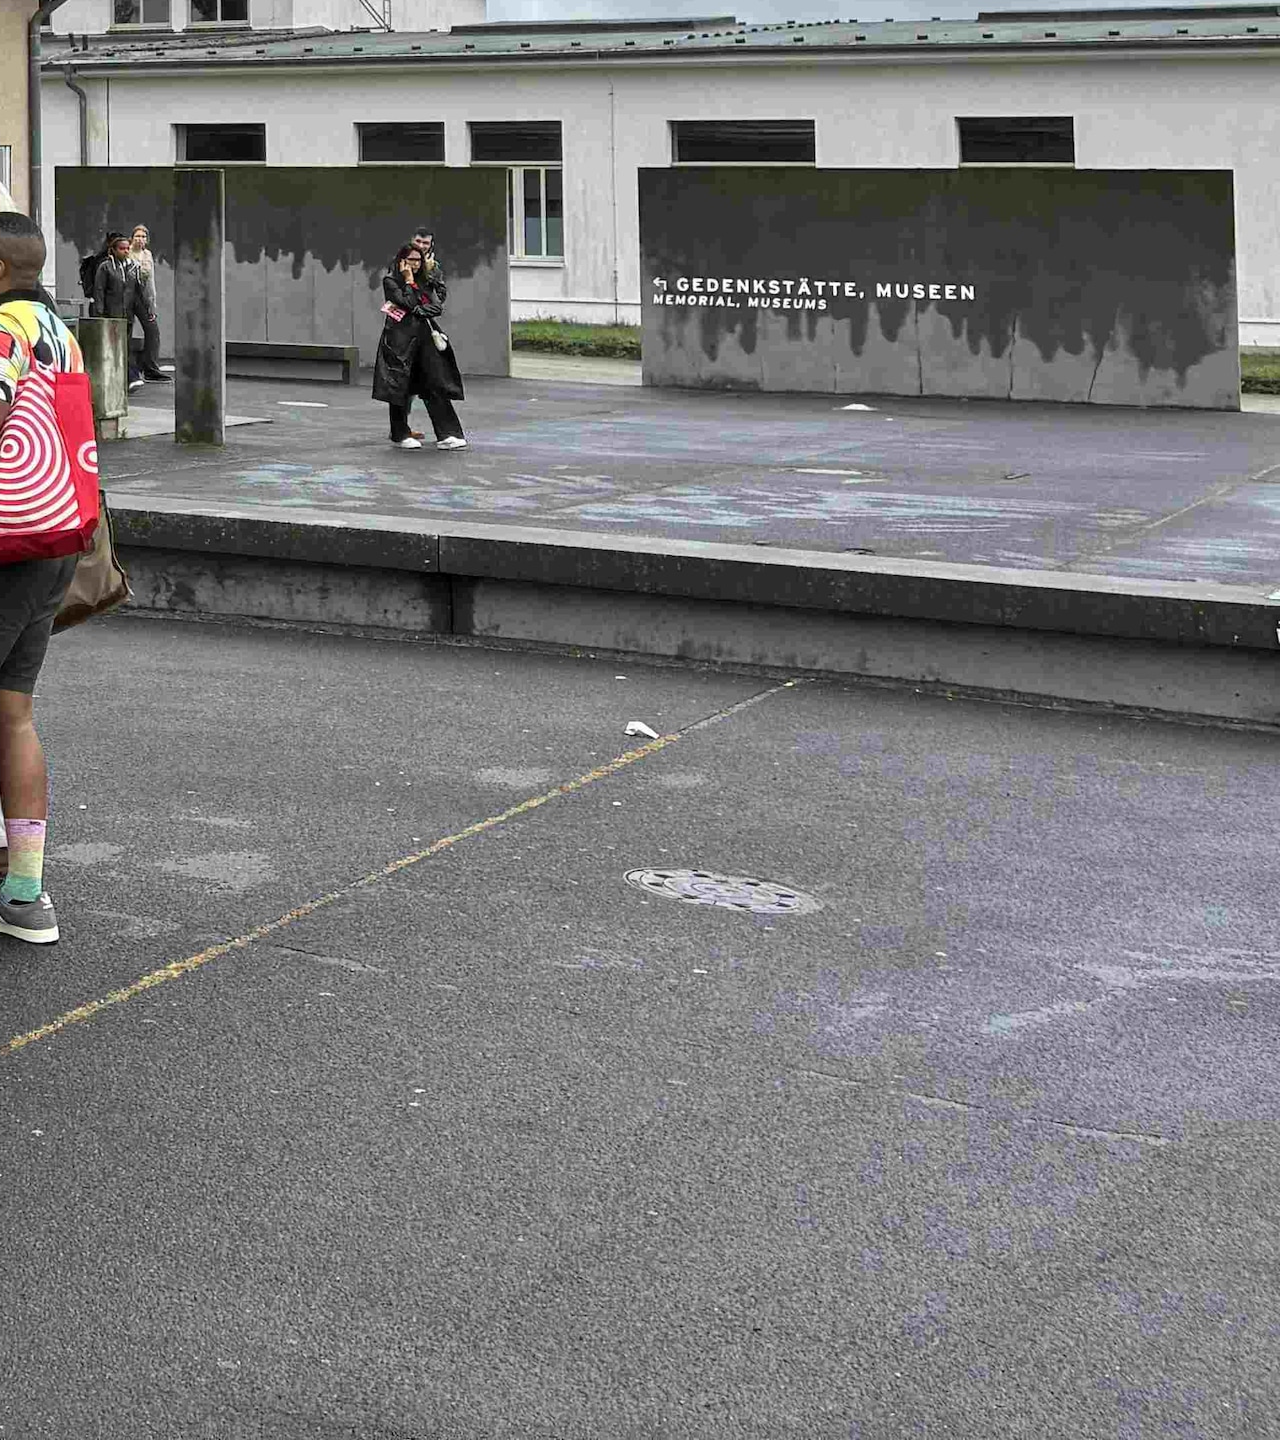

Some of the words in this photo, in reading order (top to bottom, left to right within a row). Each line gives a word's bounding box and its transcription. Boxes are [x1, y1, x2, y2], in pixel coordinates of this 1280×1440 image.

[676, 277, 865, 299] GEDENKSTÄTTE,
[876, 282, 976, 301] MUSEEN
[653, 295, 740, 309] MEMORIAL,
[748, 298, 828, 310] MUSEUMS
